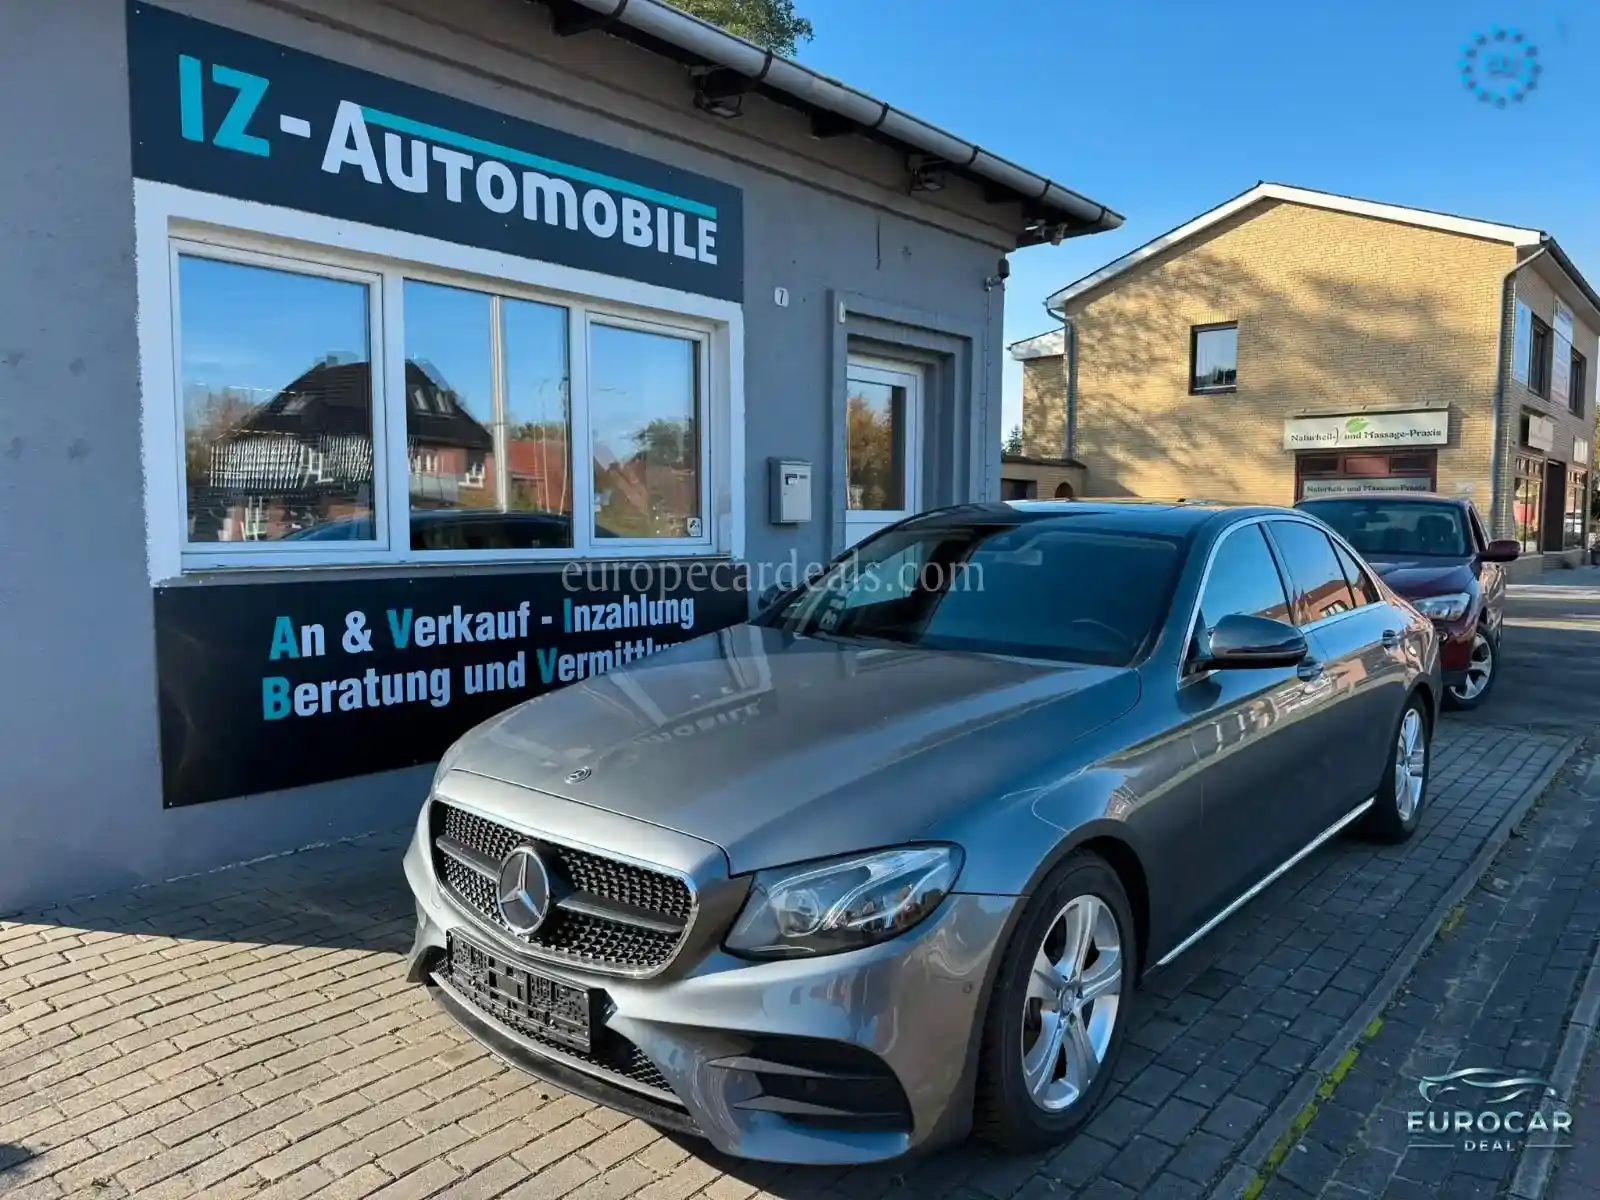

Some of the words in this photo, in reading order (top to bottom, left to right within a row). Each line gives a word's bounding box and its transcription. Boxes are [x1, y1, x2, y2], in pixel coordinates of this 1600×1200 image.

[1344, 431, 1362, 440] und
[1364, 429, 1442, 440] Massage-Praxis
[268, 616, 326, 661] An
[341, 610, 374, 654] &
[386, 601, 531, 649] Verkauf
[541, 615, 553, 625] -
[563, 594, 695, 633] Inzahlung
[262, 668, 450, 720] Beratung
[464, 651, 526, 695] und
[536, 638, 683, 684] Vermittl
